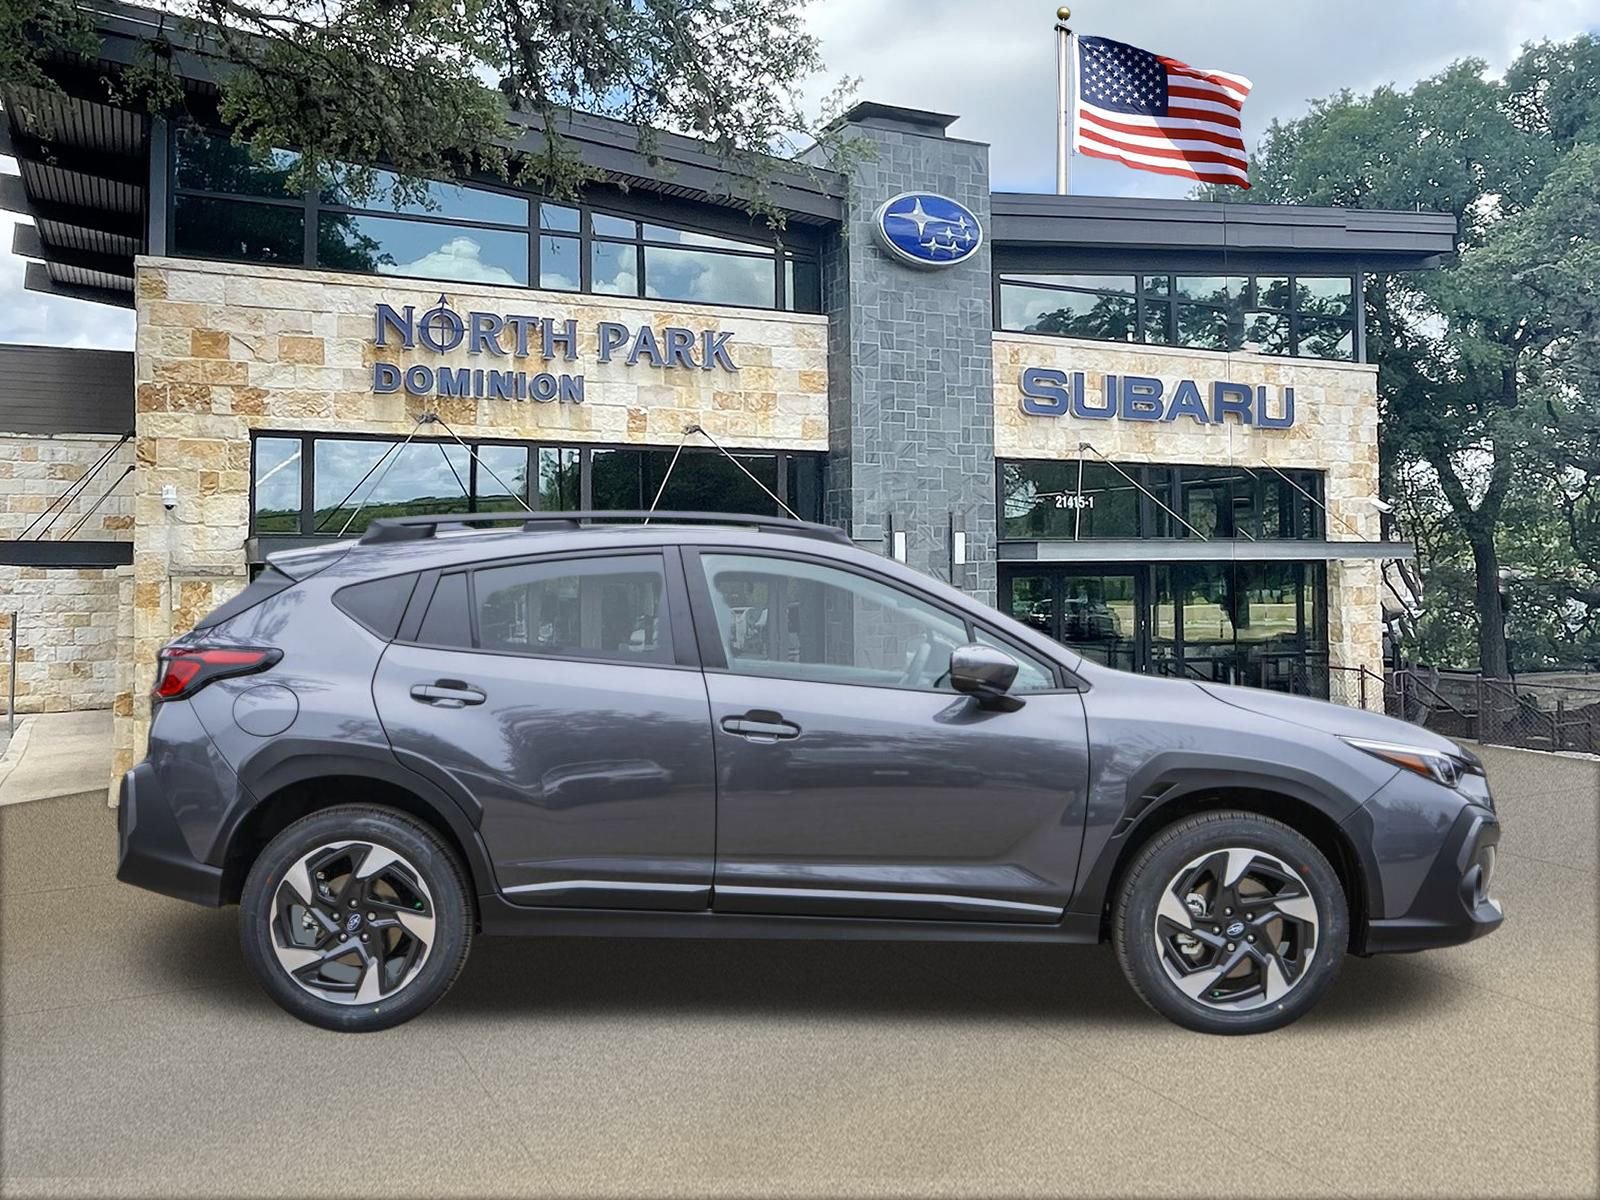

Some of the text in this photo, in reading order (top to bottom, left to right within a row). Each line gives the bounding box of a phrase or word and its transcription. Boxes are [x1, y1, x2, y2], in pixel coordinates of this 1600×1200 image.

[375, 299, 741, 373] NORTH PARK
[373, 362, 585, 404] DOMINION
[1019, 367, 1294, 429] SUBARU
